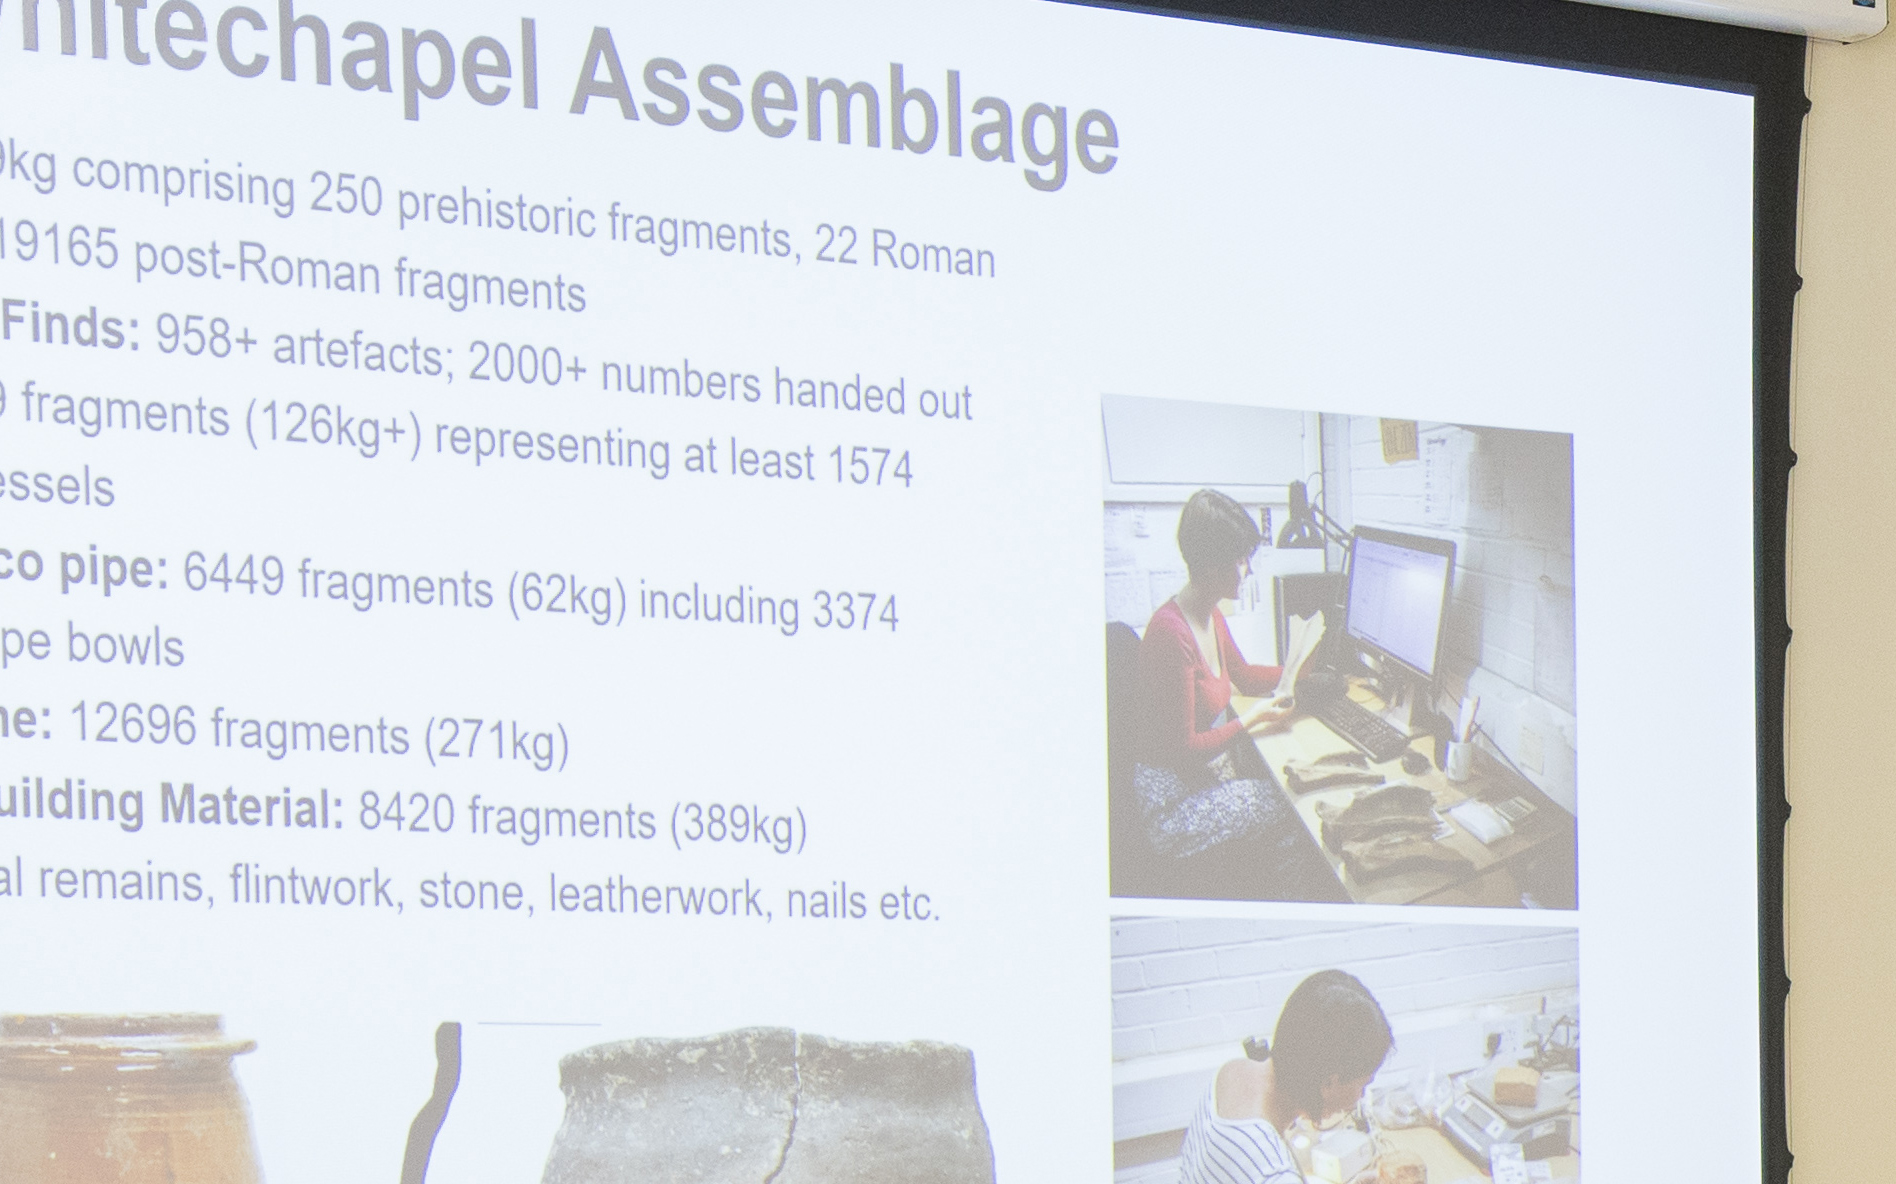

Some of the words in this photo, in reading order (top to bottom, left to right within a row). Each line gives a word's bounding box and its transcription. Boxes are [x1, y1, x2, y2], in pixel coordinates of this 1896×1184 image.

[569, 26, 1119, 193] Assemblage
[0, 138, 56, 195] kg
[73, 157, 294, 219] comprising
[311, 170, 382, 216] 250
[399, 186, 596, 238] prehistoric
[608, 202, 801, 264] fragments,
[816, 223, 857, 264] 22
[873, 228, 995, 278] Roman
[136, 241, 380, 294] post-Roman
[395, 256, 586, 313] fragments
[2, 298, 140, 352] Finds:
[157, 312, 257, 358] 958+
[274, 329, 453, 383] artefacts;
[469, 340, 587, 386] 2000+
[603, 359, 761, 403] numbers
[775, 366, 905, 415] handed
[919, 385, 972, 420] out
[21, 380, 230, 438] fragments
[246, 399, 421, 461] (126kg+)
[436, 424, 670, 480] representing
[685, 438, 718, 474] at
[731, 437, 815, 481] least
[830, 445, 913, 487] 1574
[60, 544, 167, 597] pipe:
[184, 551, 284, 596] 6449
[298, 558, 493, 612] fragments
[509, 571, 626, 626] (62kg)
[641, 579, 799, 637] including
[814, 590, 899, 632] 3374
[68, 620, 185, 667] bowls
[72, 700, 196, 746] 12696
[211, 706, 410, 761] fragments
[425, 717, 568, 772] (271kg)
[161, 782, 342, 829] Material:
[360, 790, 455, 833] 8420
[468, 794, 656, 846] fragments
[671, 802, 807, 854] (389kg)
[40, 868, 214, 908] remains,
[230, 862, 403, 913] flintwork,
[420, 872, 534, 916] stone,
[551, 873, 772, 921] leatherwork,
[788, 881, 867, 919] nails
[880, 886, 939, 921] etc.
